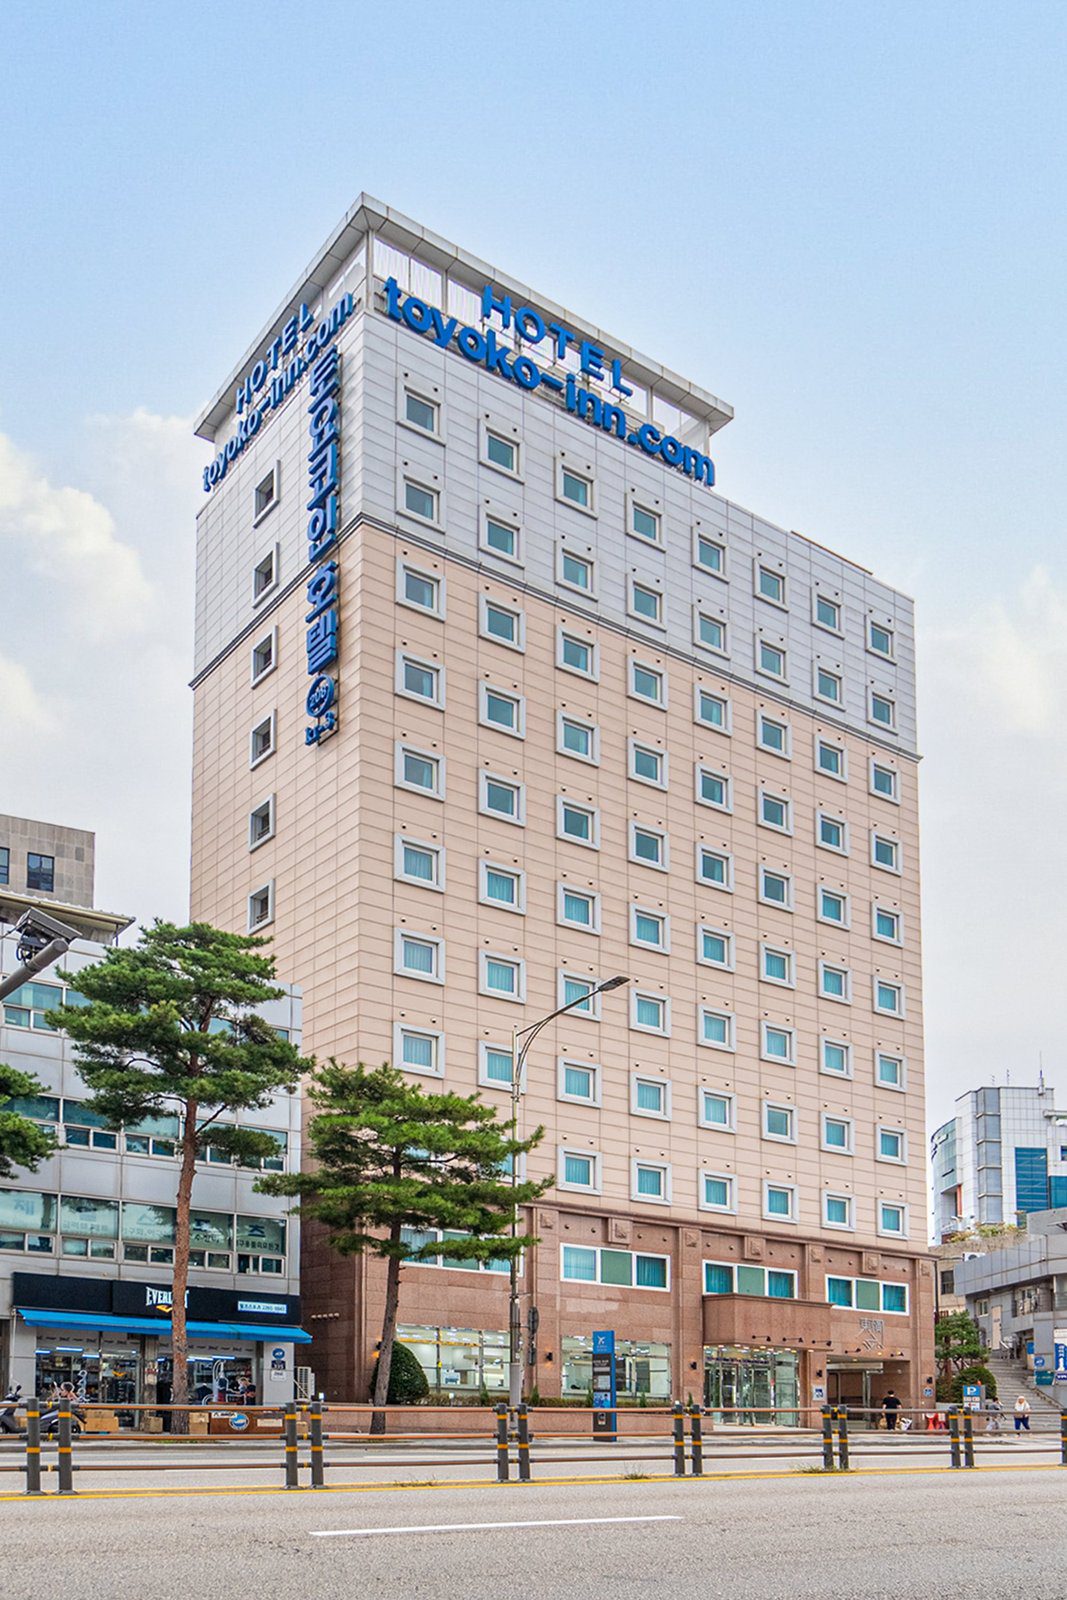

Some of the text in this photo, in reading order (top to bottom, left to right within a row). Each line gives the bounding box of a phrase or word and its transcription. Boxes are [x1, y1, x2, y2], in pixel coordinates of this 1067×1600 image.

[202, 292, 353, 492] toyoko-inn.com
[236, 303, 314, 414] HOTEL
[384, 276, 715, 486] toyoko-inn.com
[482, 284, 633, 397] HOTEL
[305, 344, 338, 676] 토요코인 호텔
[146, 1286, 190, 1309] EVERLT
[967, 1386, 977, 1395] P
